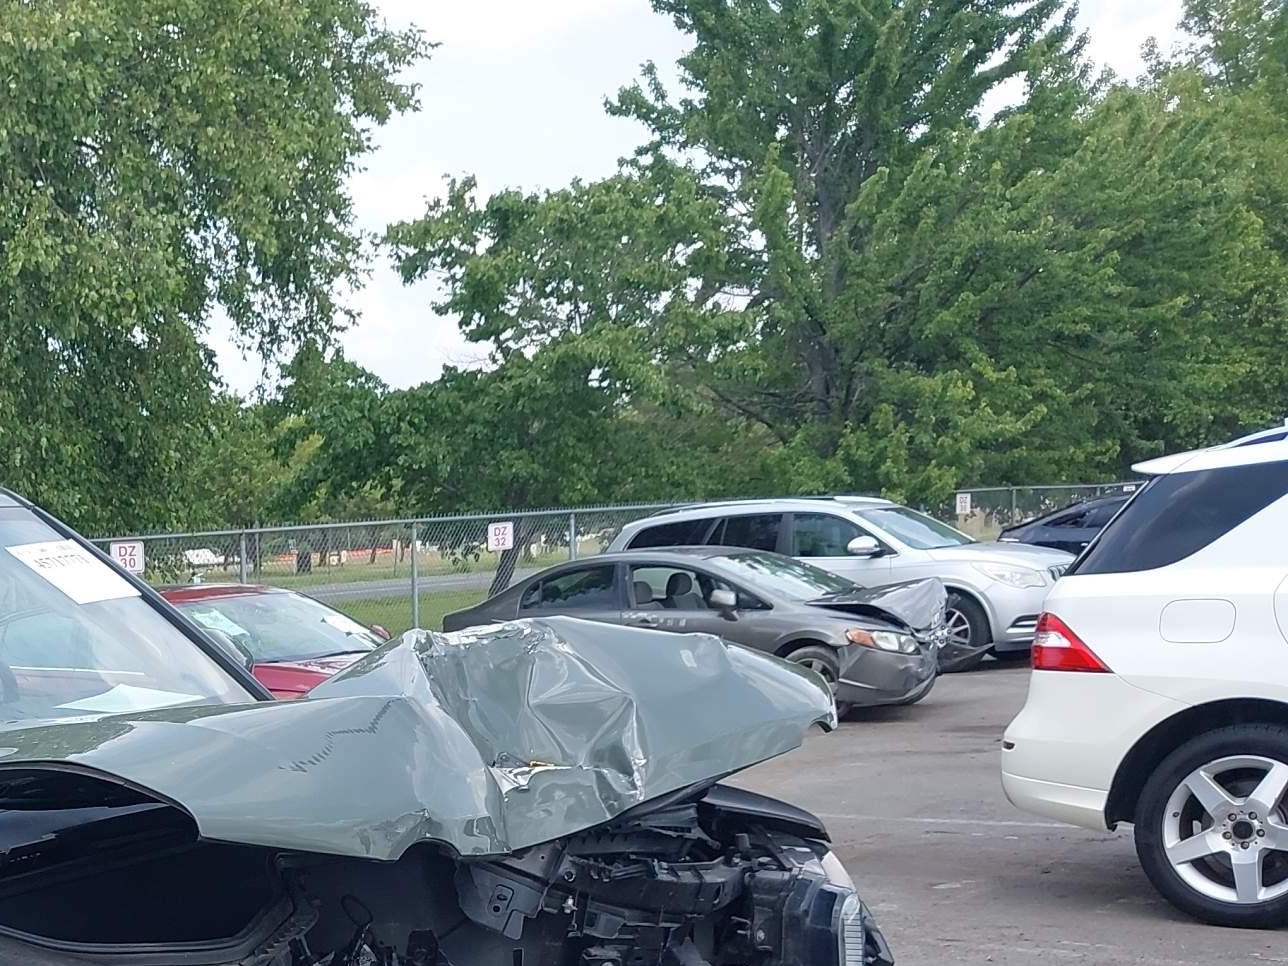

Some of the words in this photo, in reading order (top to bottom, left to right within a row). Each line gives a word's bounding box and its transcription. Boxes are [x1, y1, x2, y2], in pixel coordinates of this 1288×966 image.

[494, 527, 508, 537] DZ
[494, 537, 506, 547] 32
[118, 545, 137, 558] DZ
[120, 557, 137, 569] 30
